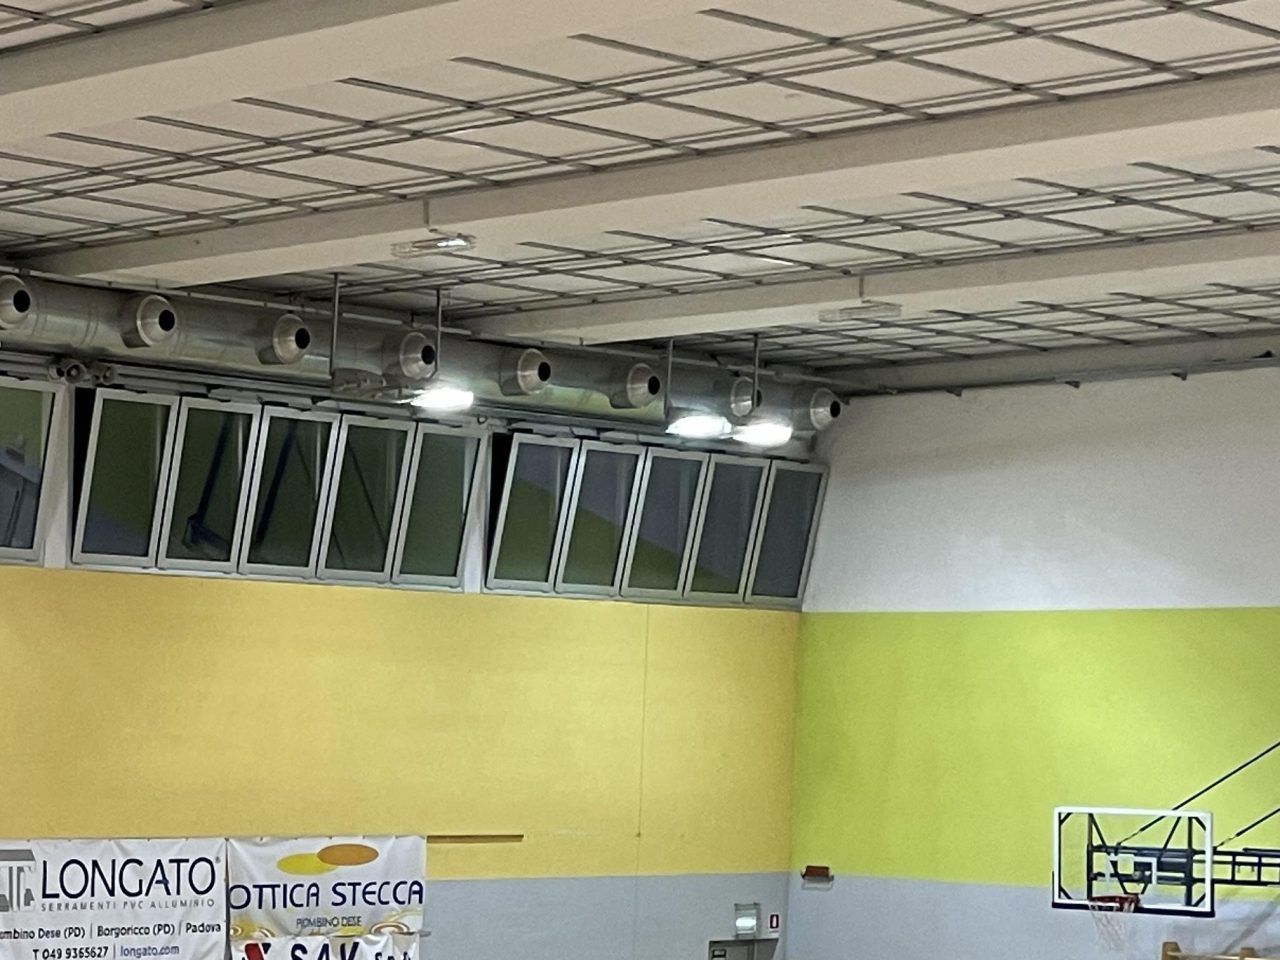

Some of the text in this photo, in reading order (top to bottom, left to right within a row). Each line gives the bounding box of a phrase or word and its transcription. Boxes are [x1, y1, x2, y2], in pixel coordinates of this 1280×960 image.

[41, 857, 216, 899] LONGATO
[229, 880, 424, 910] OTTICA STECCA
[41, 898, 215, 912] SERRAMENTI PVC ALLUMINIO
[296, 915, 363, 928] PIOMBINO DESE
[38, 927, 61, 939] Dese
[63, 926, 86, 940] (PD)
[97, 924, 150, 939] Borgoricco
[152, 923, 175, 937] (PD)
[185, 921, 221, 933] Padova
[32, 945, 180, 960] T 049 9365627 longato.com
